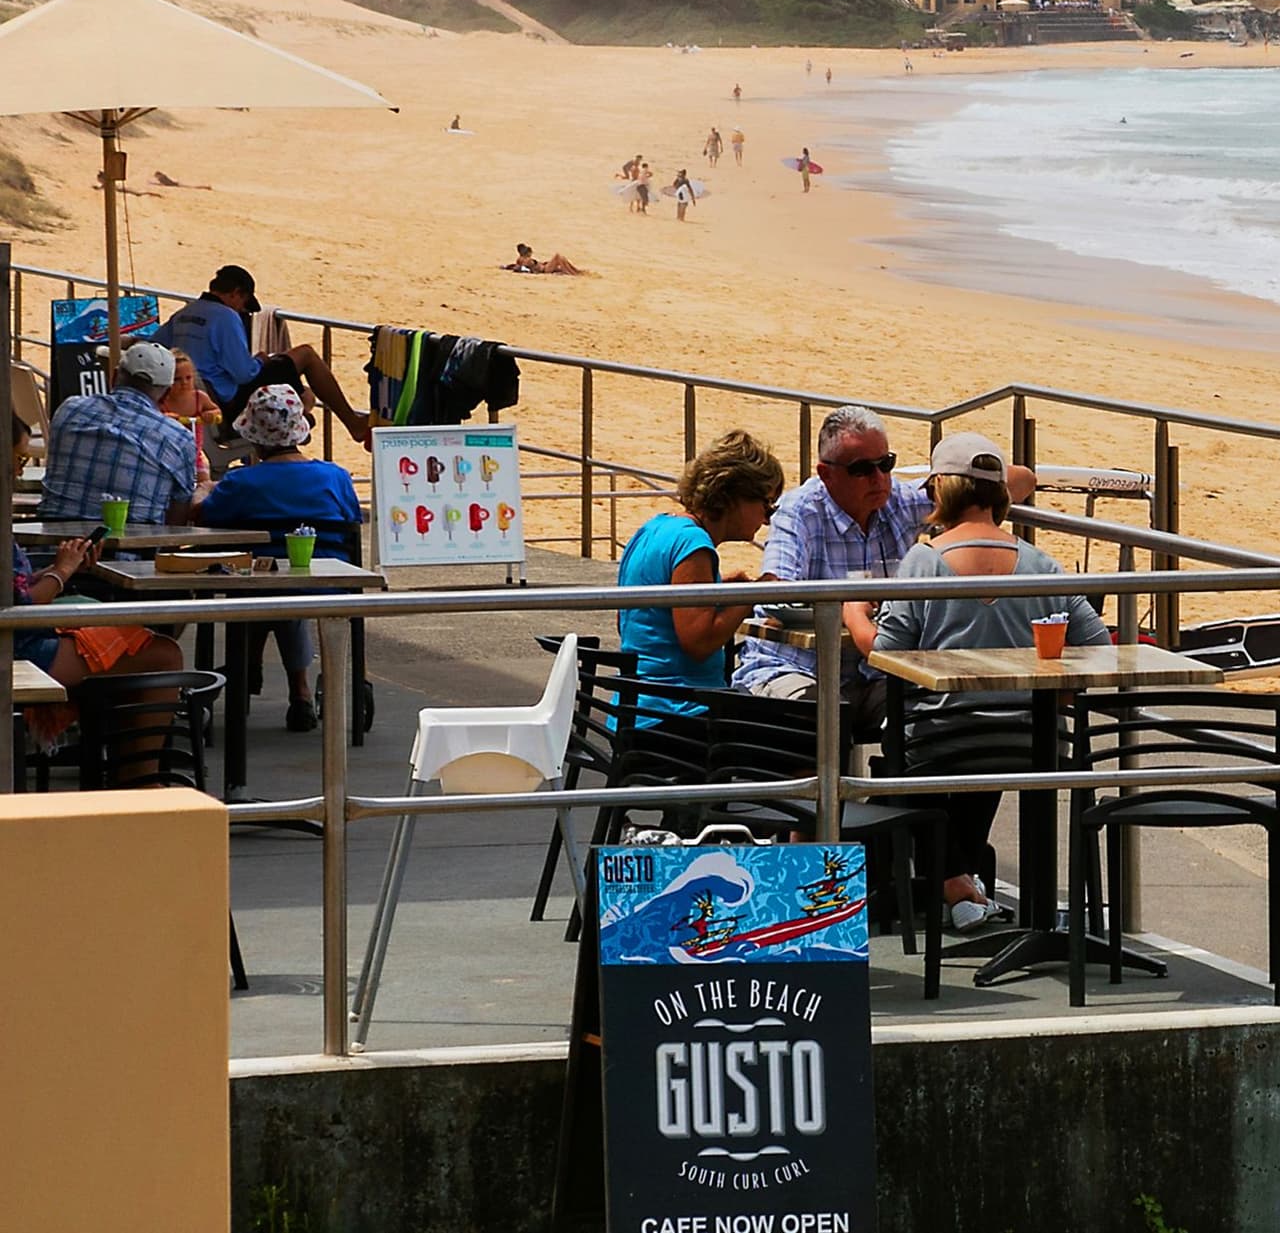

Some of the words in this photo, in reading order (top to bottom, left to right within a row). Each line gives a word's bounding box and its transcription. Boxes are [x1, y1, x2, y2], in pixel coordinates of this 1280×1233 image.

[604, 855, 653, 883] GUSTO
[654, 990, 689, 1026] ON
[694, 979, 737, 1013] THE
[750, 979, 822, 1023] BEACH
[655, 1039, 827, 1140] GUSTO
[678, 1161, 726, 1189] SOUTH
[733, 1172, 769, 1190] CURL
[774, 1159, 810, 1184] CURL
[641, 1217, 707, 1233] CAFE
[715, 1215, 775, 1233] NOW
[781, 1213, 849, 1233] OPEN
